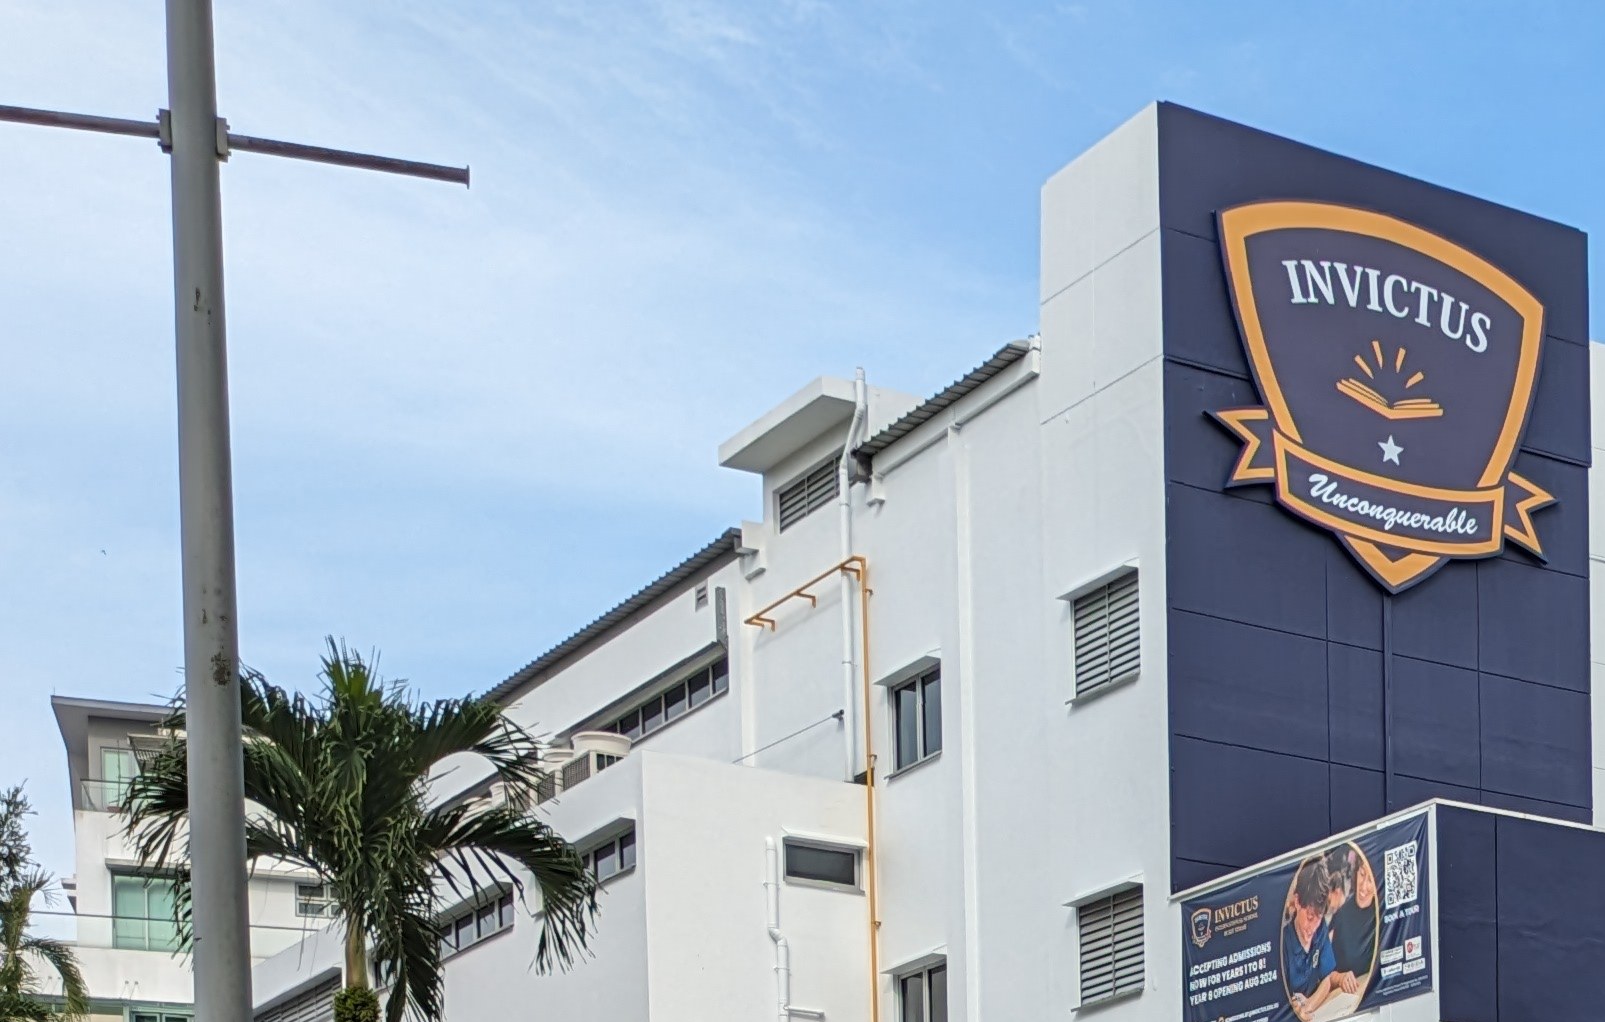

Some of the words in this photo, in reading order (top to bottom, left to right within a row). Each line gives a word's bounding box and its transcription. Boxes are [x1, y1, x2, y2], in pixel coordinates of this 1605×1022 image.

[1281, 259, 1492, 353] INVICTUS
[1308, 473, 1478, 535] Unconquerable
[1214, 895, 1259, 923] INVICTUS
[1189, 956, 1228, 977] ACCEPTING
[1228, 941, 1272, 965] ADMISSIONS
[1189, 978, 1208, 992] NOW
[1208, 972, 1221, 986] FOR
[1222, 965, 1243, 982] YEARS
[1248, 961, 1257, 973] TO
[1189, 991, 1207, 1007] YEAR
[1213, 980, 1244, 999] OPENING
[1244, 976, 1259, 990] AUG
[1259, 969, 1278, 985] 2024
